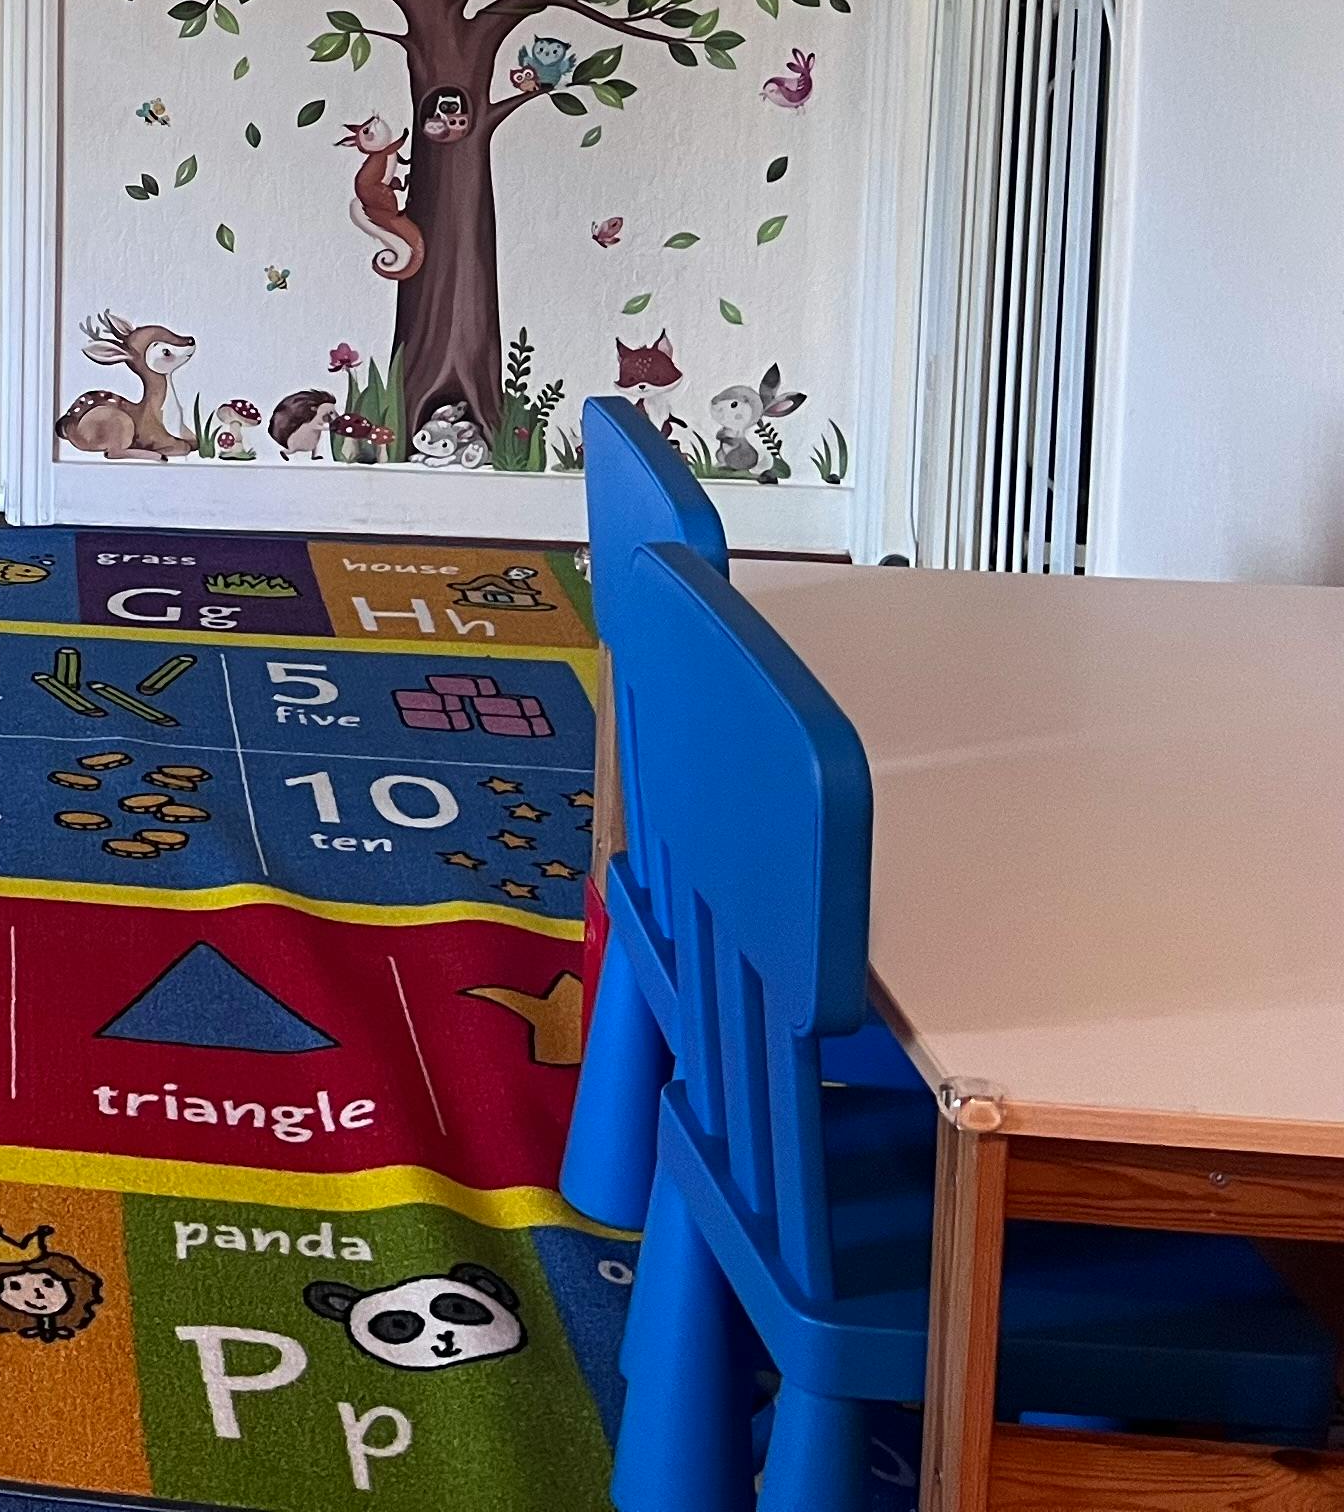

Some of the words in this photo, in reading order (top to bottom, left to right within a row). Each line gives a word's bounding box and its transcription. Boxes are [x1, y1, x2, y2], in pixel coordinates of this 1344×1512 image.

[97, 550, 196, 565] grass
[343, 559, 459, 574] house
[267, 662, 338, 705] 5
[276, 706, 360, 726] five
[285, 772, 458, 828] 10
[310, 834, 392, 851] ten
[93, 1086, 375, 1142] triangle
[174, 1222, 372, 1261] panda
